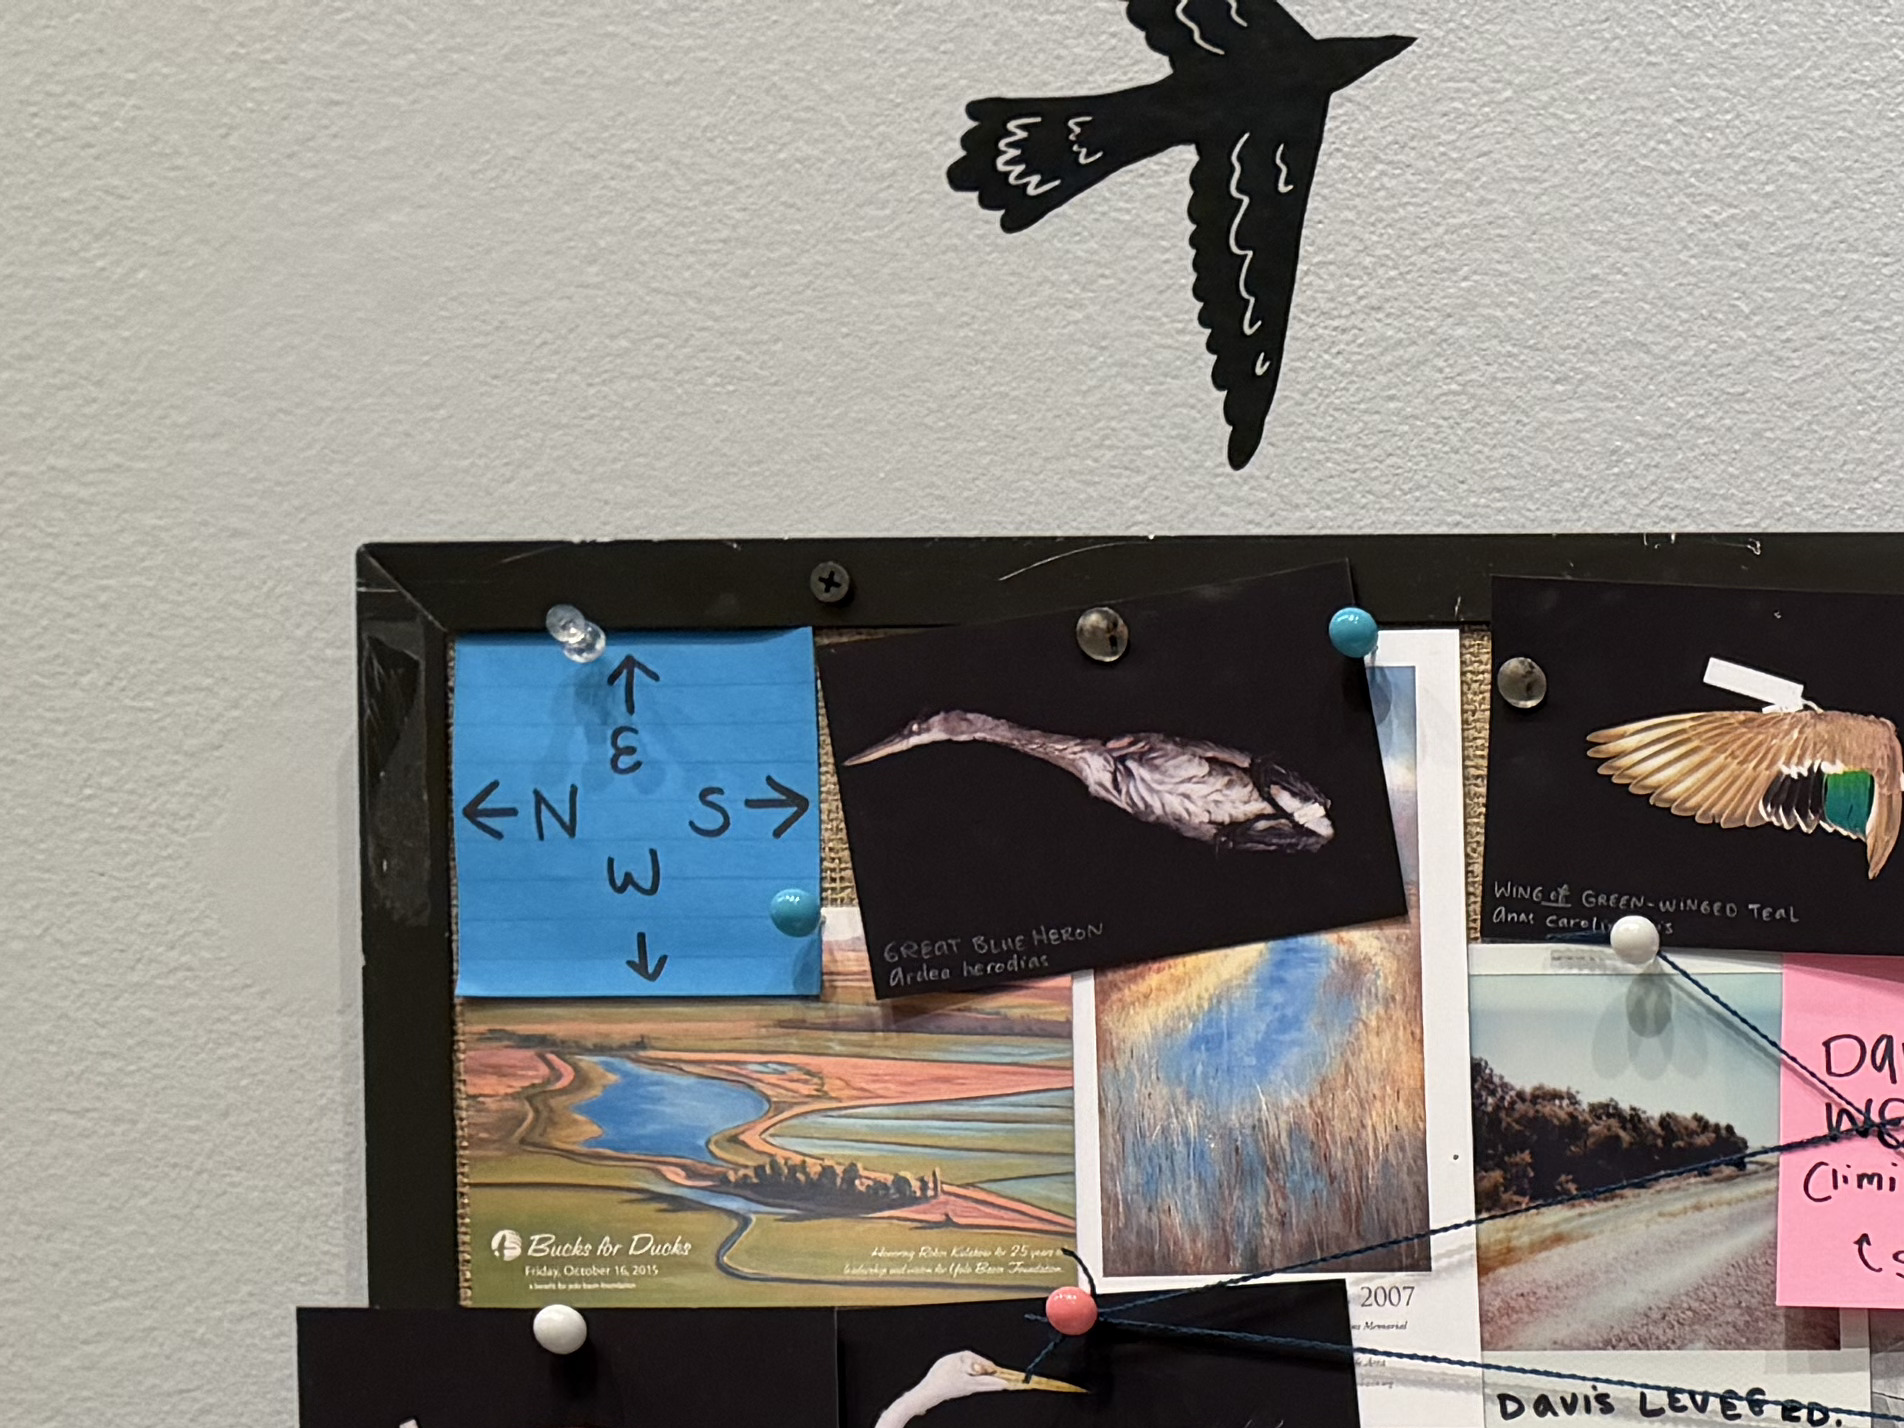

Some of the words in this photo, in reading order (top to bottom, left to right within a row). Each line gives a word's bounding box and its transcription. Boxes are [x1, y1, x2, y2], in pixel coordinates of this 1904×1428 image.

[528, 1234, 592, 1256] Bucks
[597, 1236, 622, 1256] for
[629, 1234, 691, 1255] Ducks
[525, 1266, 558, 1278] Friday,
[1361, 1286, 1414, 1307] 2007
